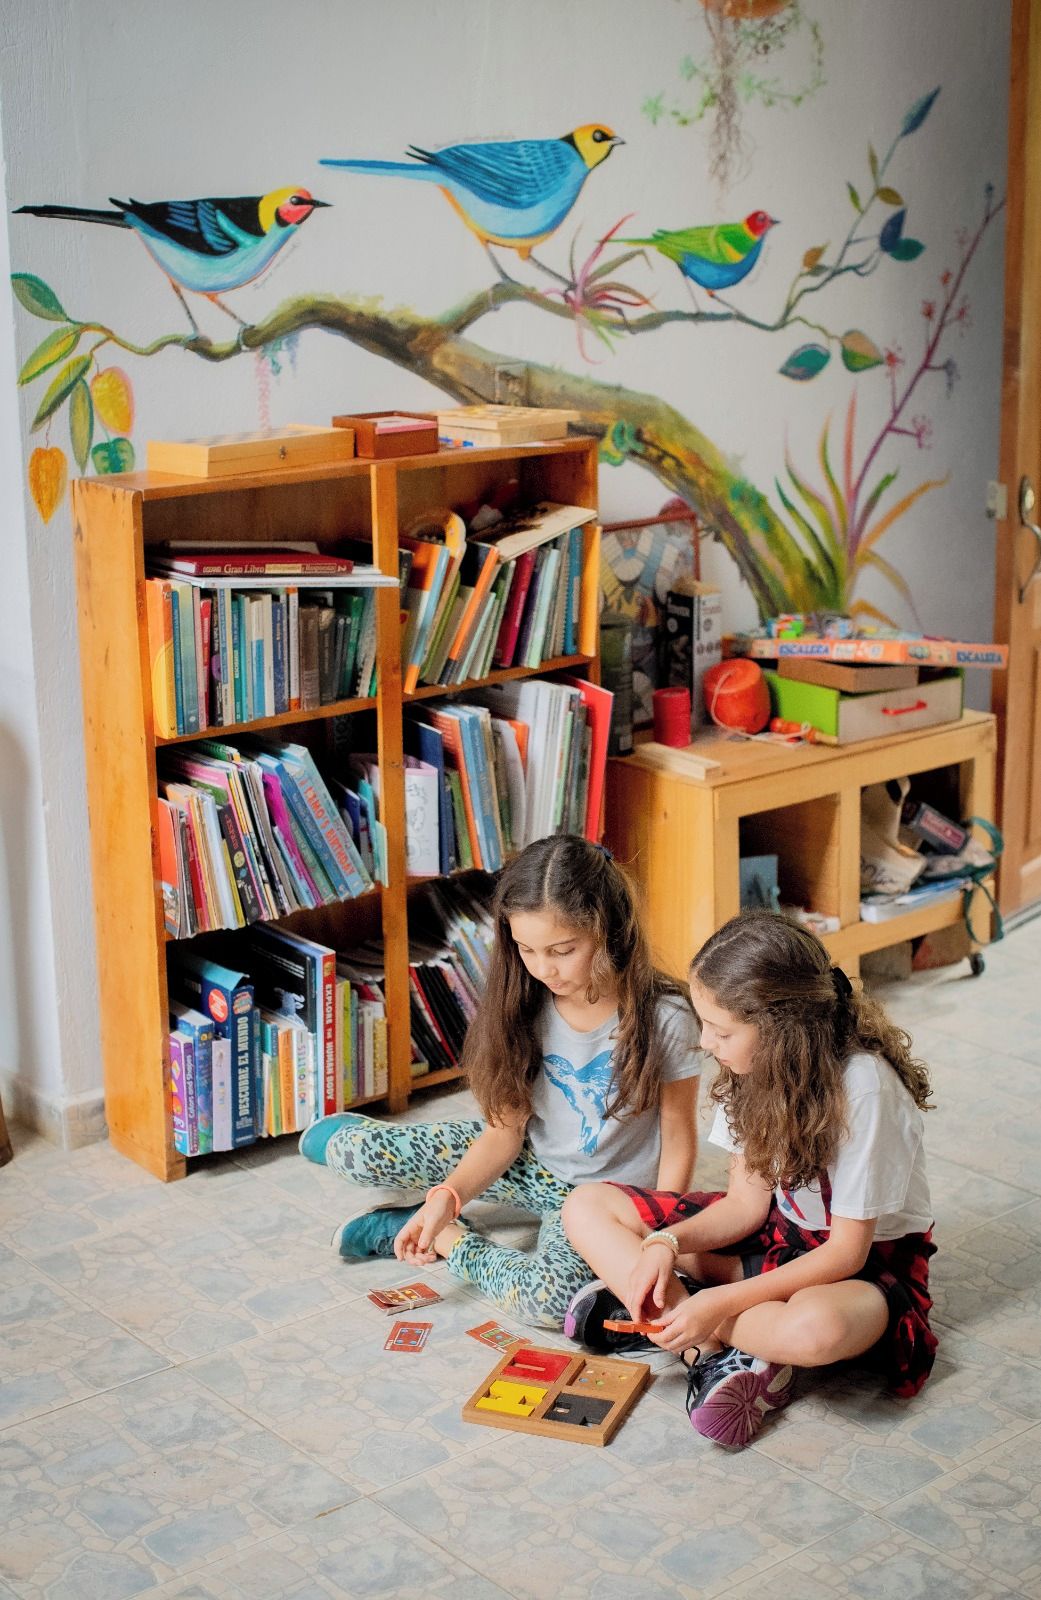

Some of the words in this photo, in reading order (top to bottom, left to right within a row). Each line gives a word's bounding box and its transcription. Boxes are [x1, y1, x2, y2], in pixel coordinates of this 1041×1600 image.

[223, 564, 243, 574] Gran
[244, 564, 265, 574] Libro
[325, 983, 333, 1025] EXPLORE
[237, 1016, 249, 1052] MUNDO
[185, 1055, 195, 1081] Shapes
[237, 1052, 249, 1066] EL
[326, 1041, 334, 1074] HUMAN
[186, 1081, 195, 1096] and
[237, 1066, 250, 1117] DESCUBRE
[326, 1075, 334, 1101] BODY
[187, 1096, 196, 1119] Colors
